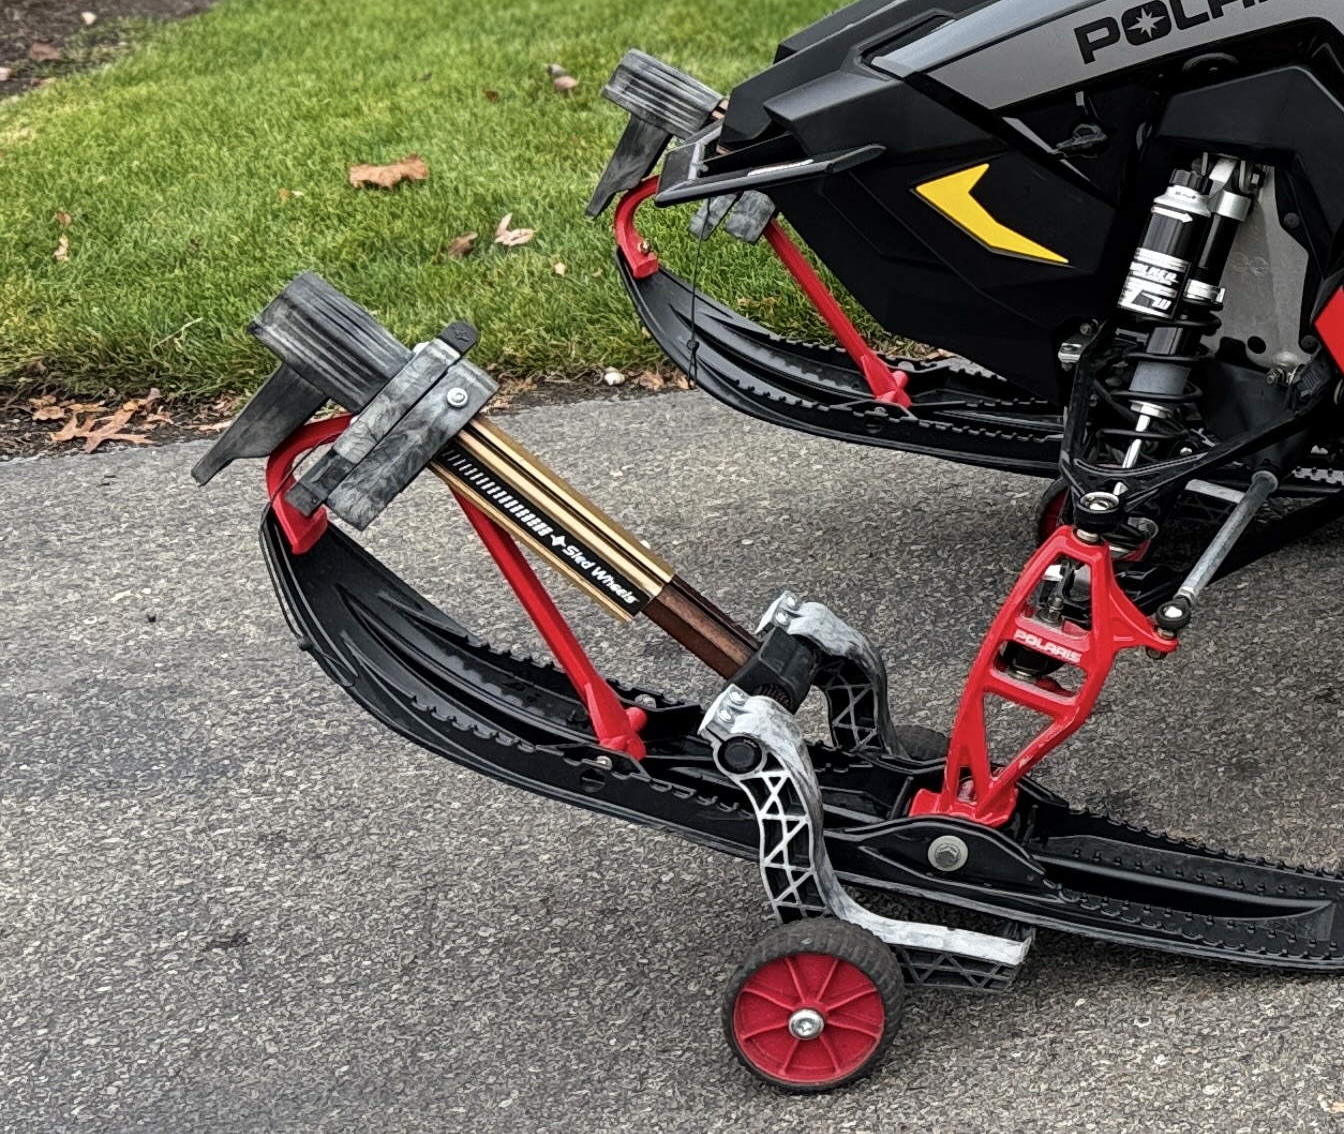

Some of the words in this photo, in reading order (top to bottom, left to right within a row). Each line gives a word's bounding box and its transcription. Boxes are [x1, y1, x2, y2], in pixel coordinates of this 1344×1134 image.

[562, 545, 596, 570] Sled
[591, 566, 641, 604] Wheels
[1013, 628, 1083, 664] POLARIS
